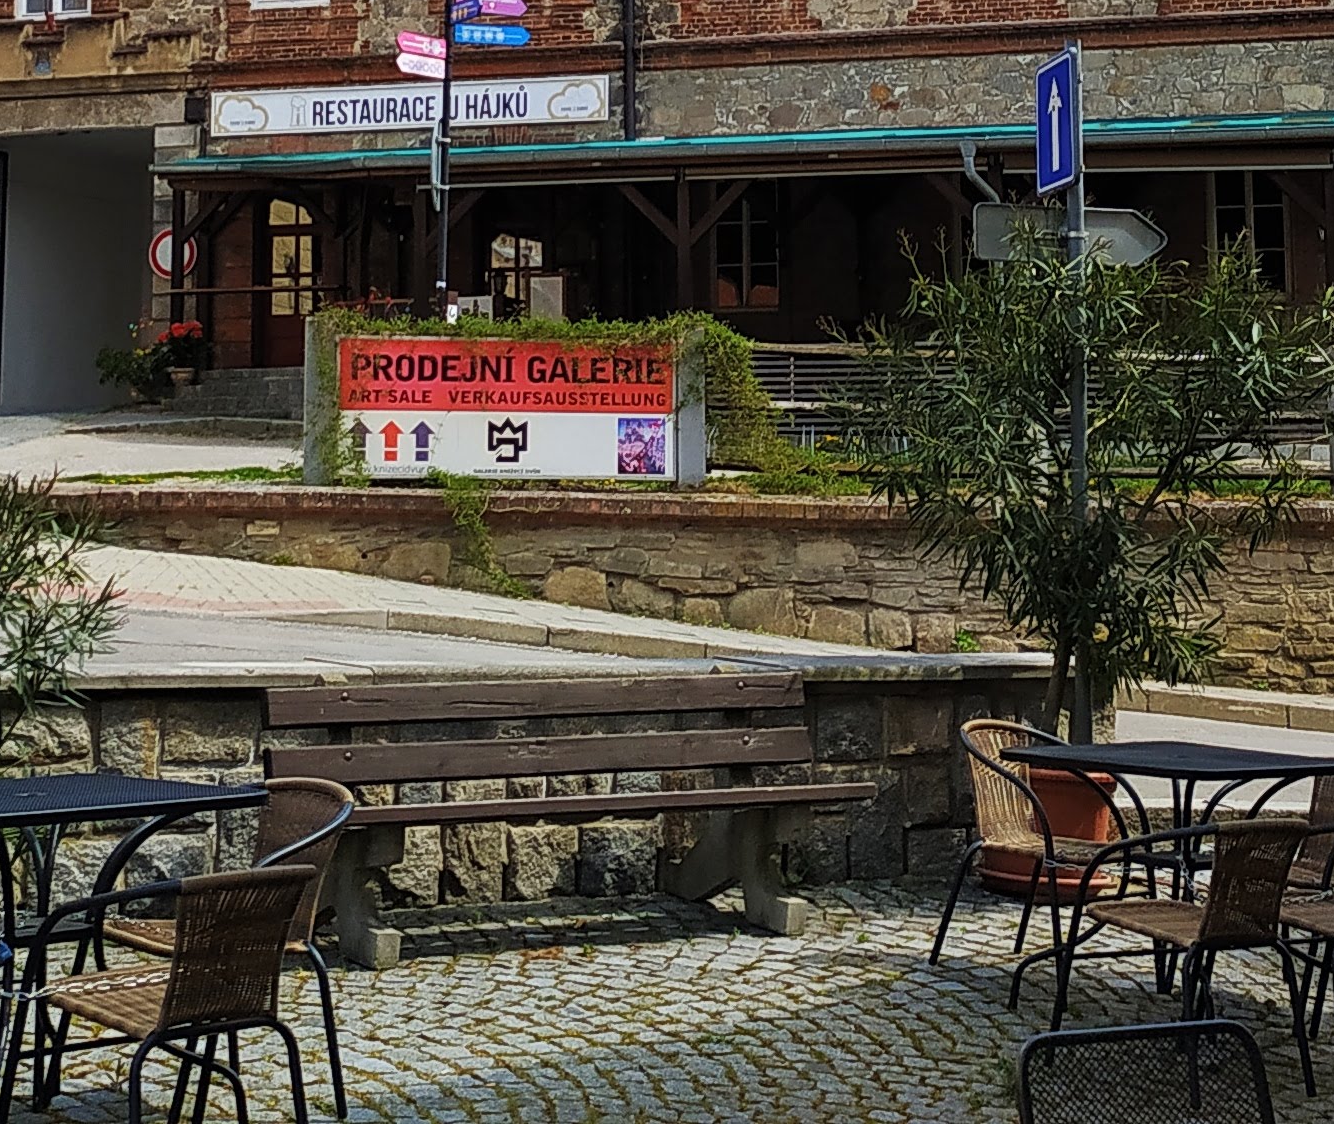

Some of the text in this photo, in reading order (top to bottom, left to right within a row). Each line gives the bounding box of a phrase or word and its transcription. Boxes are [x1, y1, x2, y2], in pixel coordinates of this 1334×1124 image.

[313, 85, 528, 126] RESTAURACE U HÁJKŮ
[351, 348, 667, 385] PRODEJNÍ GALERIE
[348, 389, 666, 407] ART SALE VERKAUFSAUSSTELLUNG
